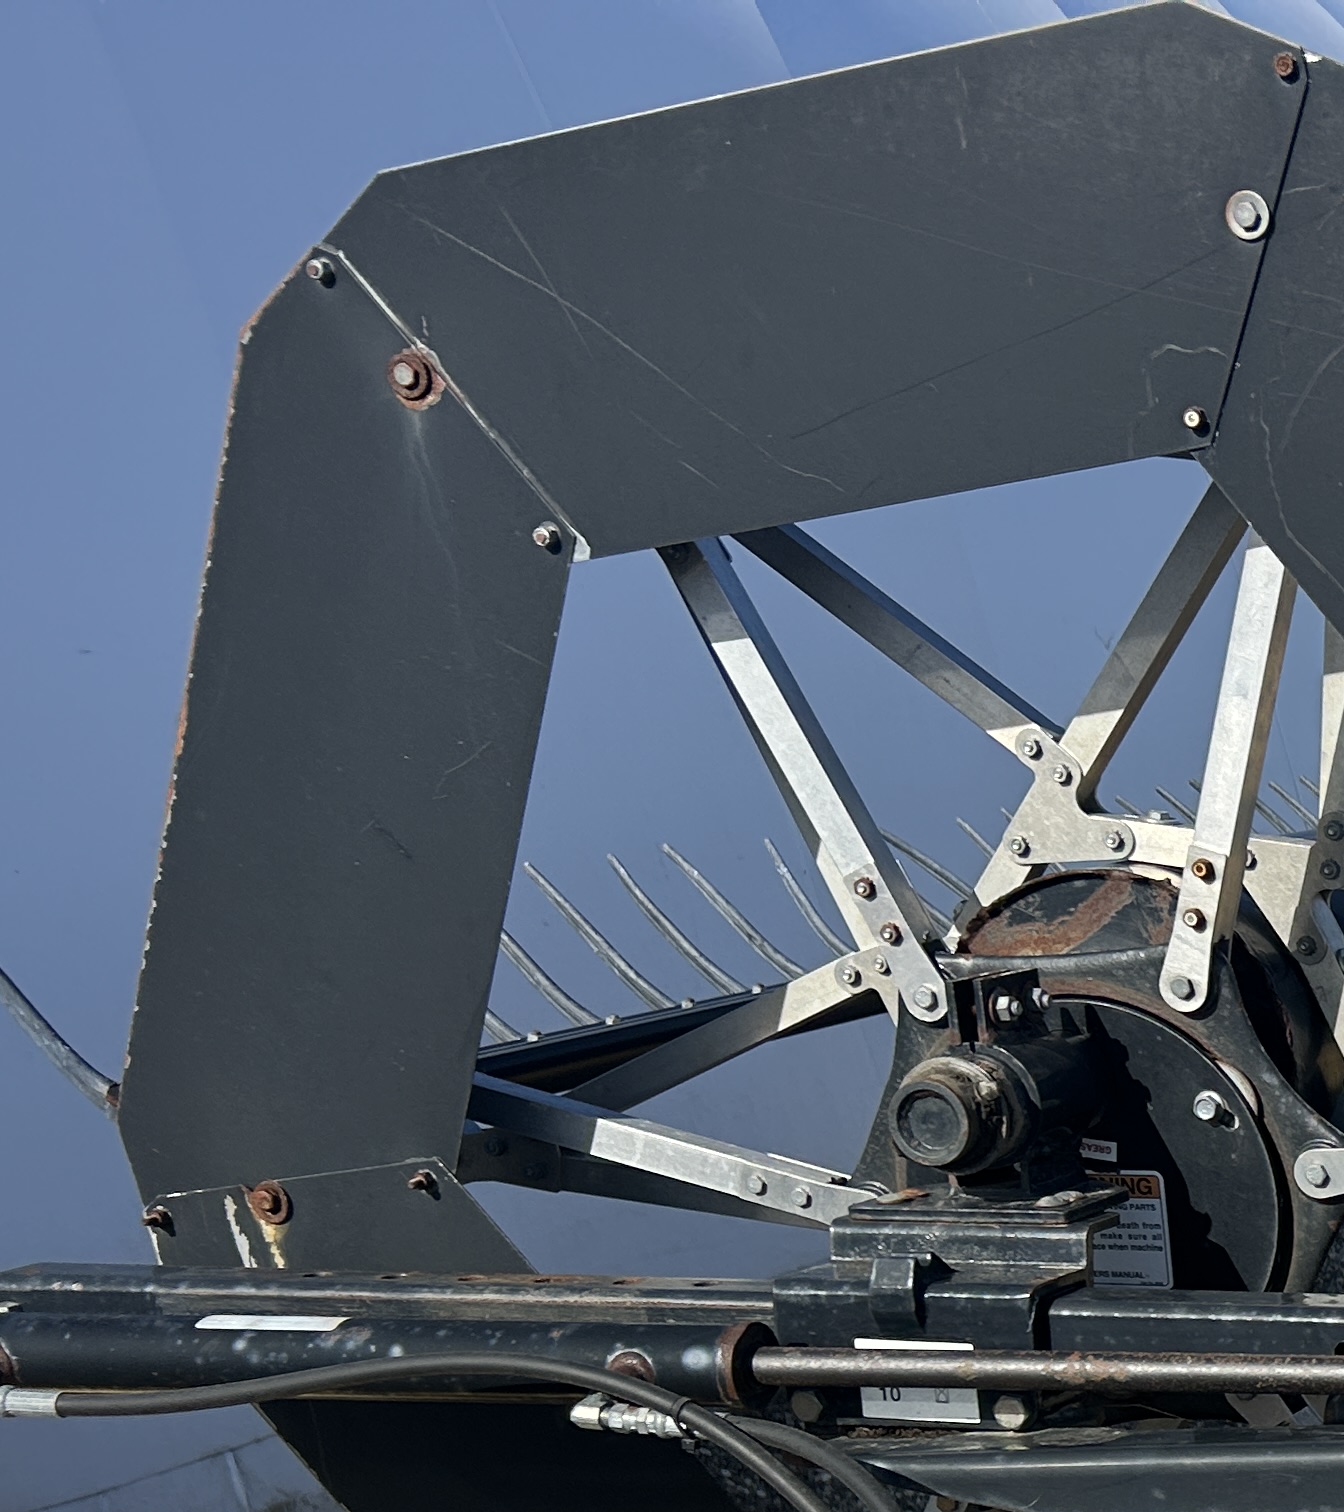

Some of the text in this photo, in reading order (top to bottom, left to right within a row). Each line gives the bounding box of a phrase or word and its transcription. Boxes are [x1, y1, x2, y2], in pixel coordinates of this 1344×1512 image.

[1079, 1142, 1112, 1155] GREAS
[1129, 1203, 1157, 1211] PARTS
[1142, 1222, 1161, 1231] from
[1100, 1232, 1163, 1241] make sure all
[1108, 1243, 1129, 1251] when
[1130, 1243, 1163, 1252] machine
